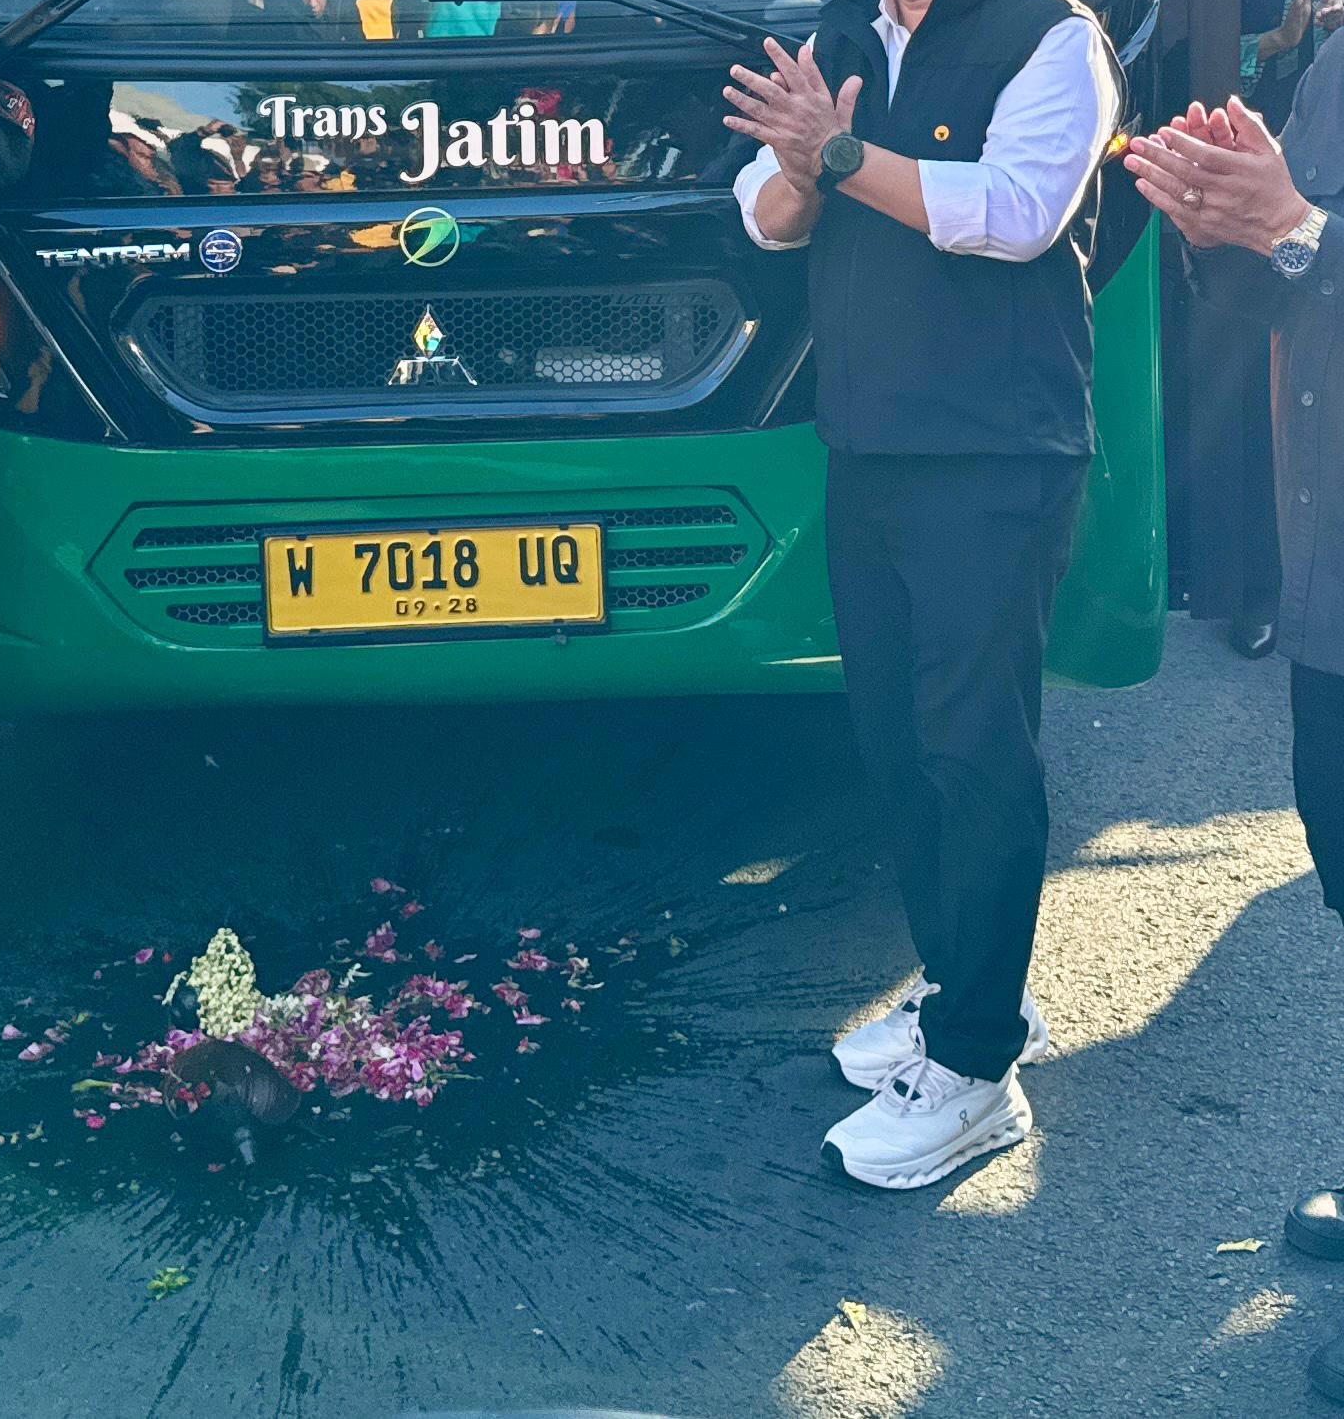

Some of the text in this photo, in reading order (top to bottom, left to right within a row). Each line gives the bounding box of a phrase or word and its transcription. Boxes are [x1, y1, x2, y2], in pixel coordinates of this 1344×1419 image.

[259, 94, 610, 183] Trans Jatim
[36, 242, 191, 269] TENTREM
[286, 534, 582, 597] W 7018 UQ
